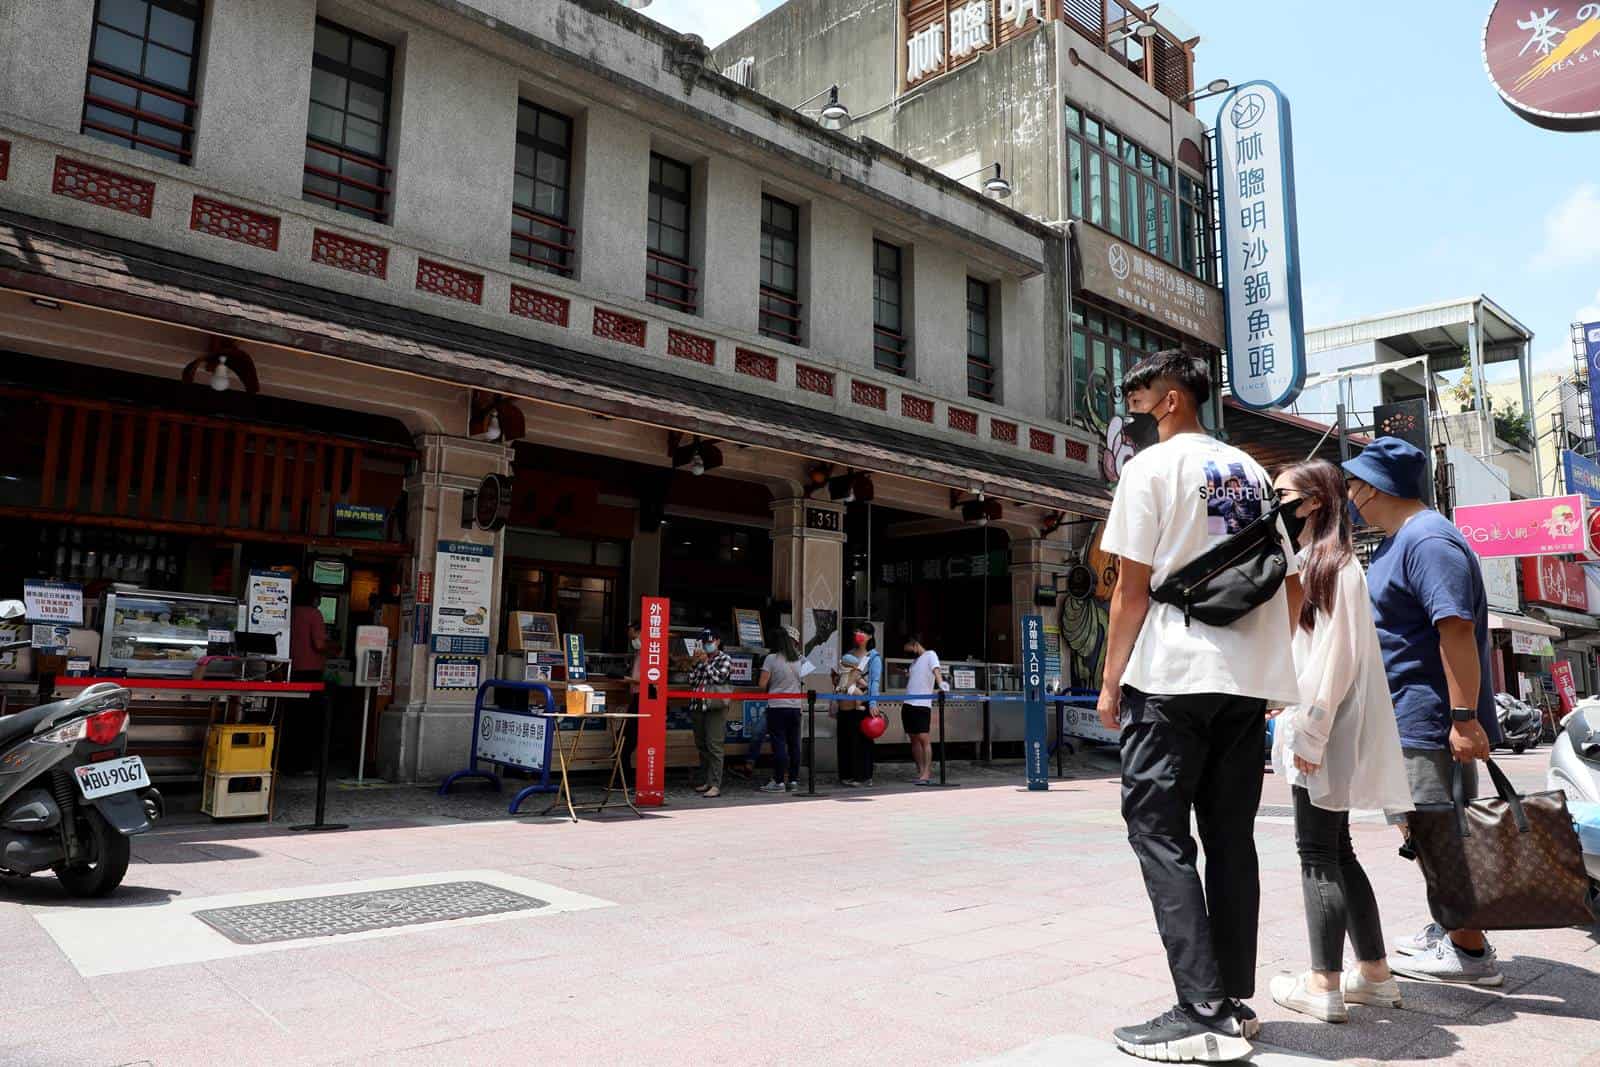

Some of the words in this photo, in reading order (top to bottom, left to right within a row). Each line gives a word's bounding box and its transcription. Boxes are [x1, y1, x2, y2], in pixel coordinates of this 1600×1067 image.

[1552, 58, 1575, 73] TEA
[1236, 132, 1275, 378] 林聰明沙鍋魚頭
[1199, 485, 1272, 502] SPORTFUL
[648, 641, 661, 665] 出口
[1029, 652, 1040, 673] 入口
[80, 763, 142, 791] MBU-9067
